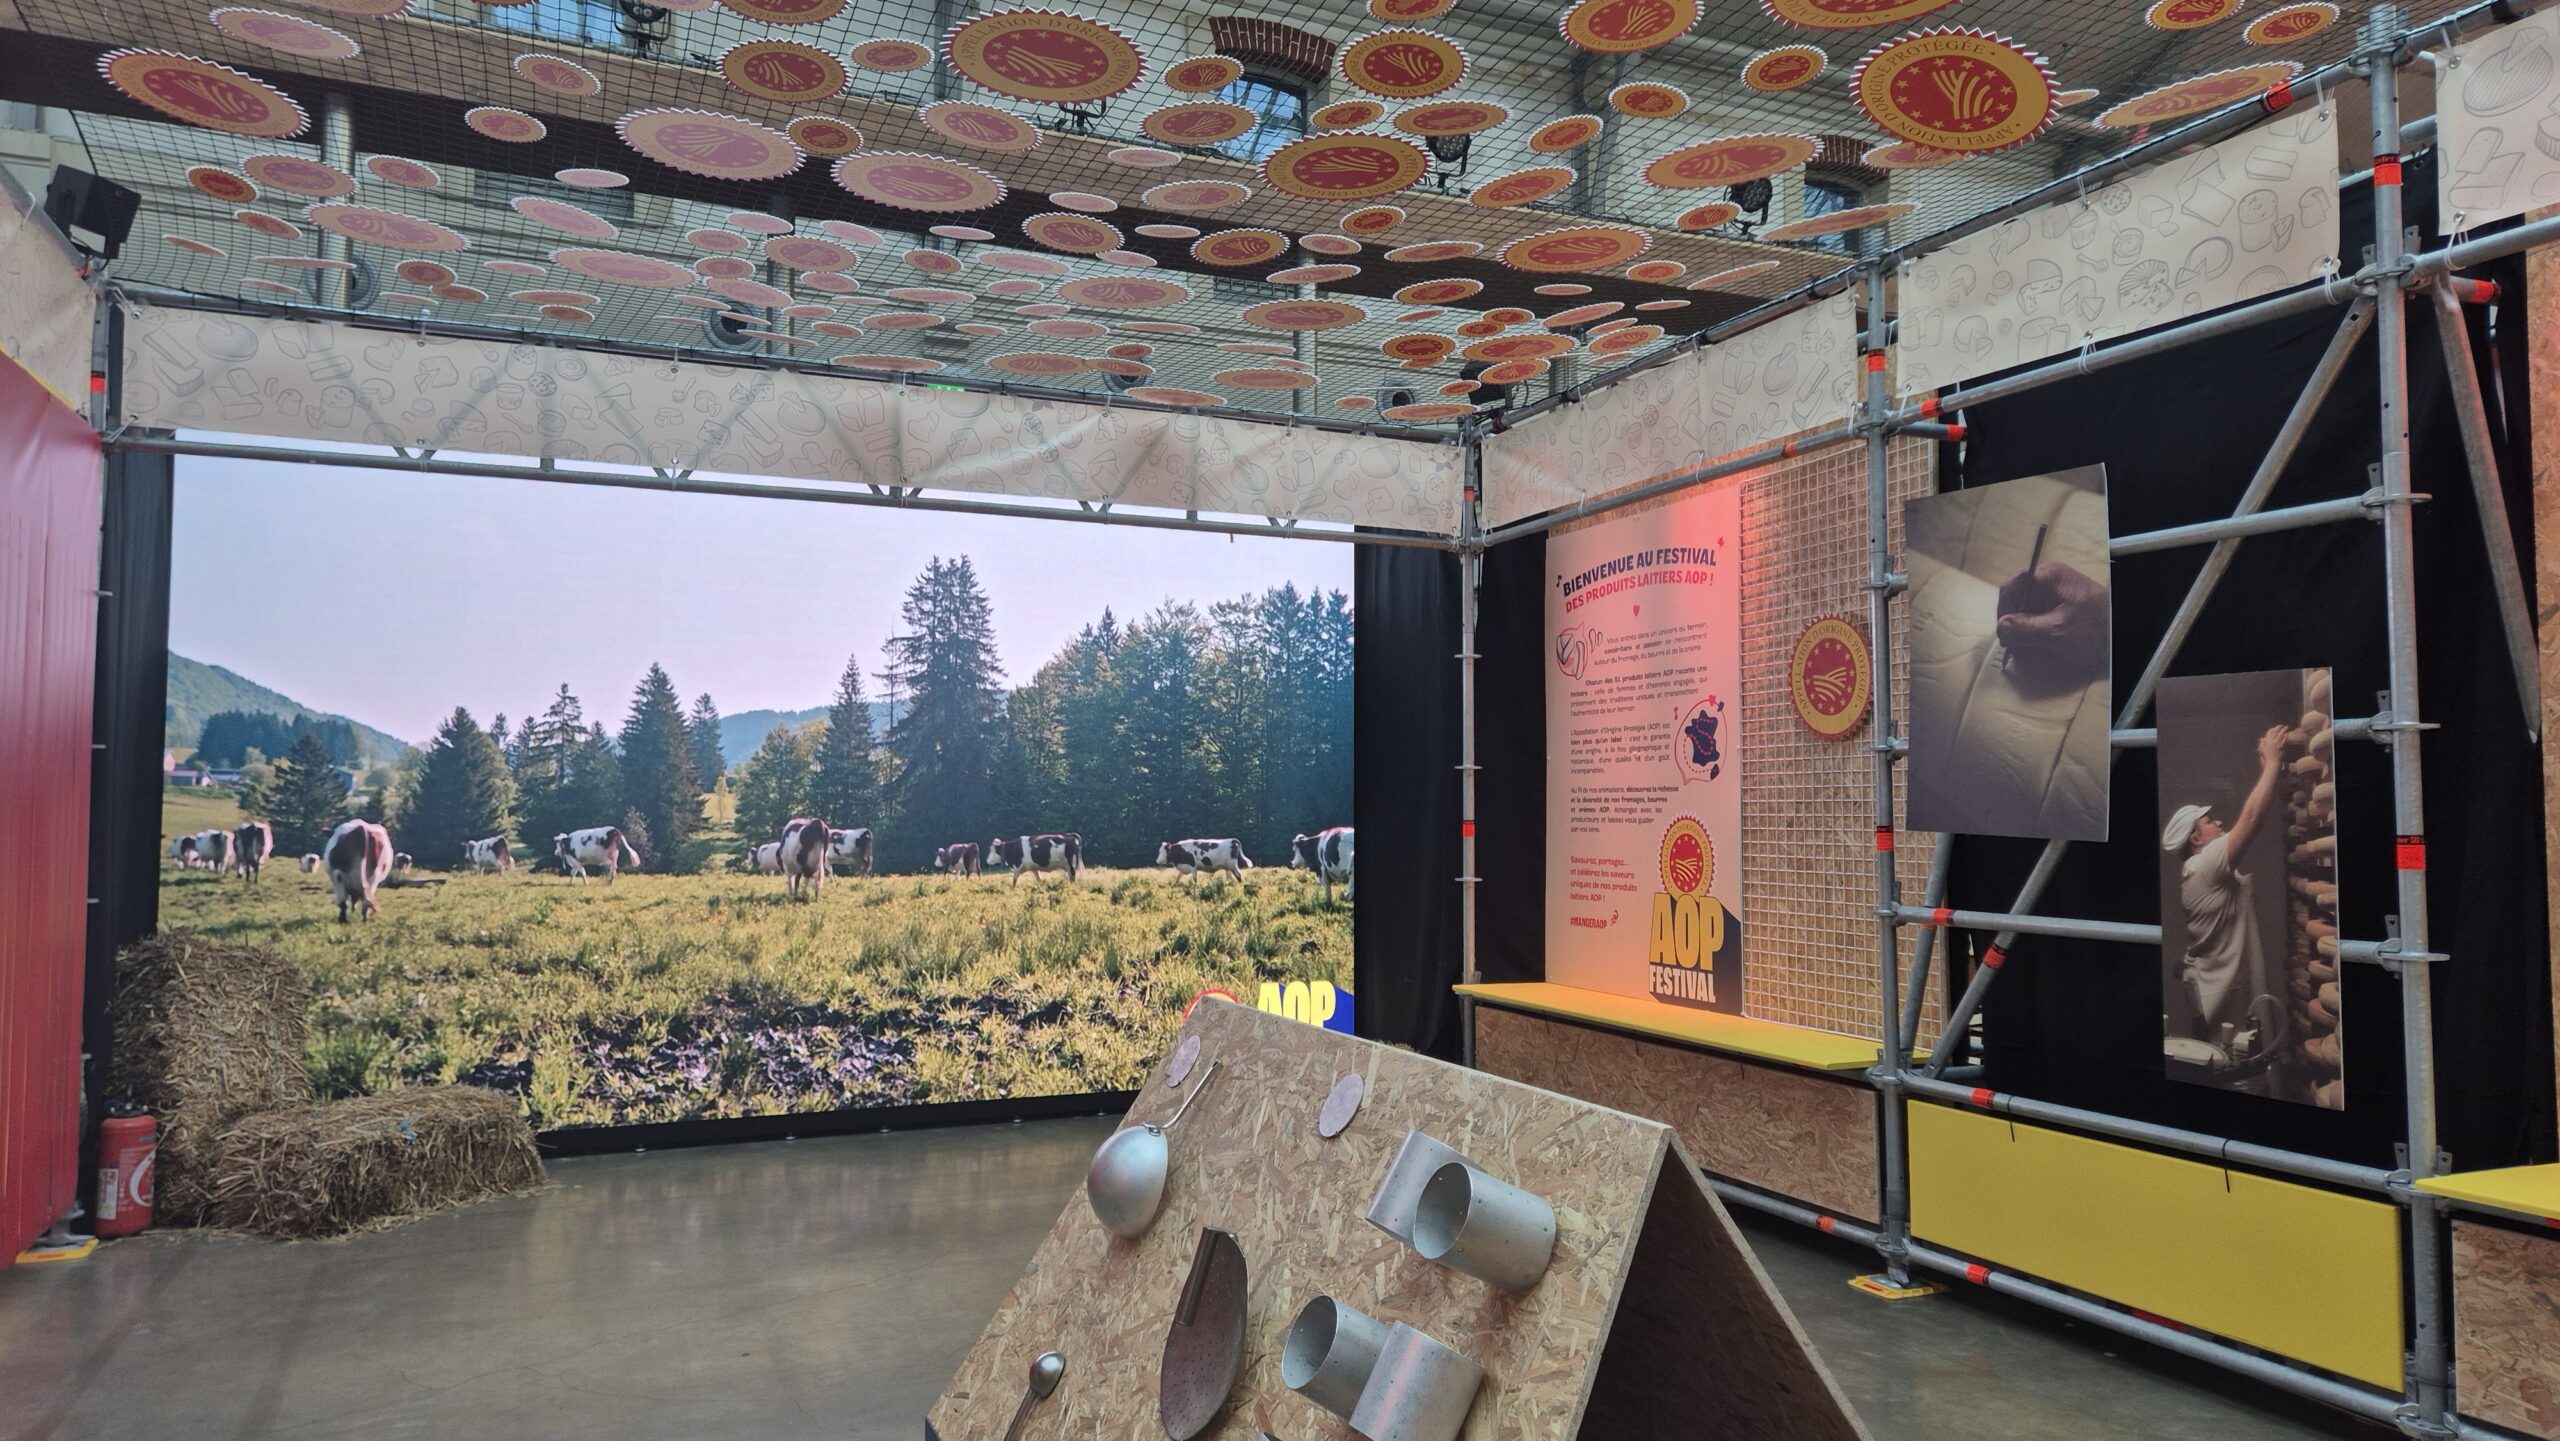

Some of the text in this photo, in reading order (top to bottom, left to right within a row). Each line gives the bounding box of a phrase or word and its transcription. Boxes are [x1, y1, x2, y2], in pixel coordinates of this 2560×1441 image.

[961, 16, 1041, 60] APPELLATION
[1891, 38, 1985, 66] PROTÉGÉE
[1899, 121, 2015, 146] APPELLATION
[1563, 548, 1716, 597] BIENVENUE AU FESTIVAL
[1566, 595, 1584, 613] DES
[1586, 576, 1636, 603] PRODUITS
[1638, 570, 1682, 587] LAITIERS
[1685, 570, 1707, 584] AOP
[1795, 640, 1812, 710] APPELLATION
[1571, 856, 1597, 865] Savourez,
[1601, 869, 1609, 877] les
[1610, 871, 1635, 879] saveurs
[1570, 880, 1591, 889] uniques
[1593, 881, 1599, 889] de
[1612, 883, 1637, 893] produits
[1570, 892, 1589, 900] laitiers
[1570, 916, 1607, 929] #MANGERAOP
[1649, 892, 1724, 971] AOP
[1650, 964, 1716, 1004] FESTIVAL
